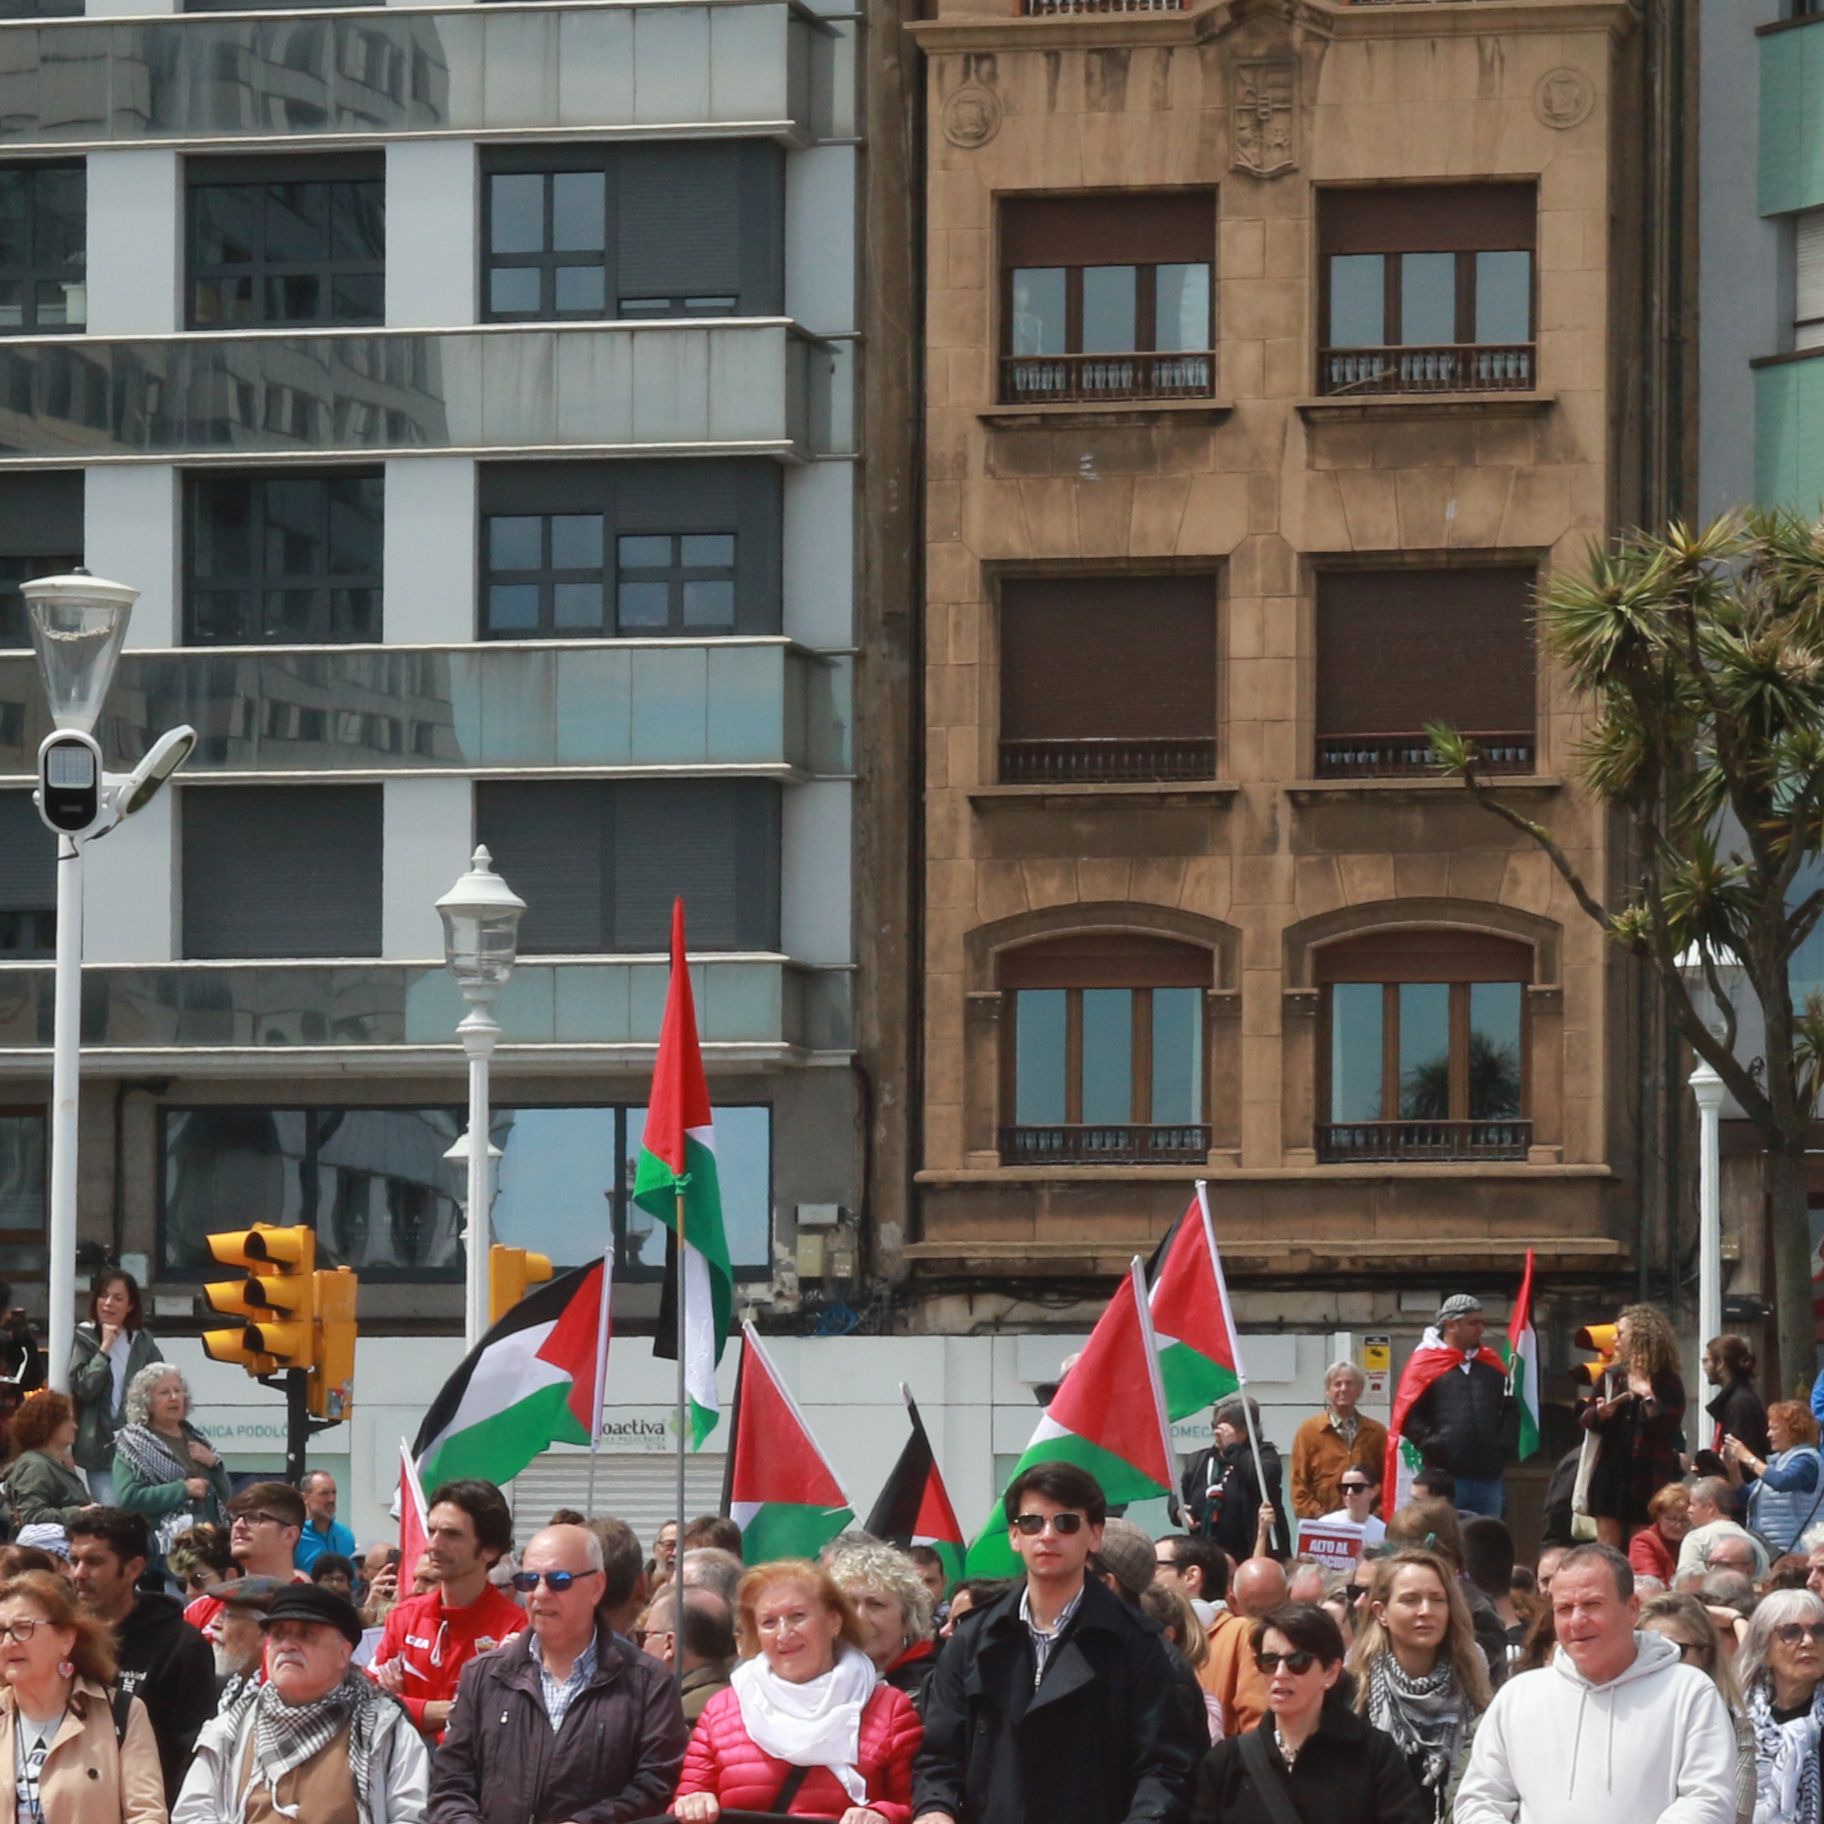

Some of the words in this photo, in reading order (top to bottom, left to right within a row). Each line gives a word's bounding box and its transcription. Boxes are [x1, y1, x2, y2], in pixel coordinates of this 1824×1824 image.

[602, 1418, 665, 1436] oactiva
[1309, 1539, 1334, 1553] ALTO
[1335, 1541, 1348, 1555] AL
